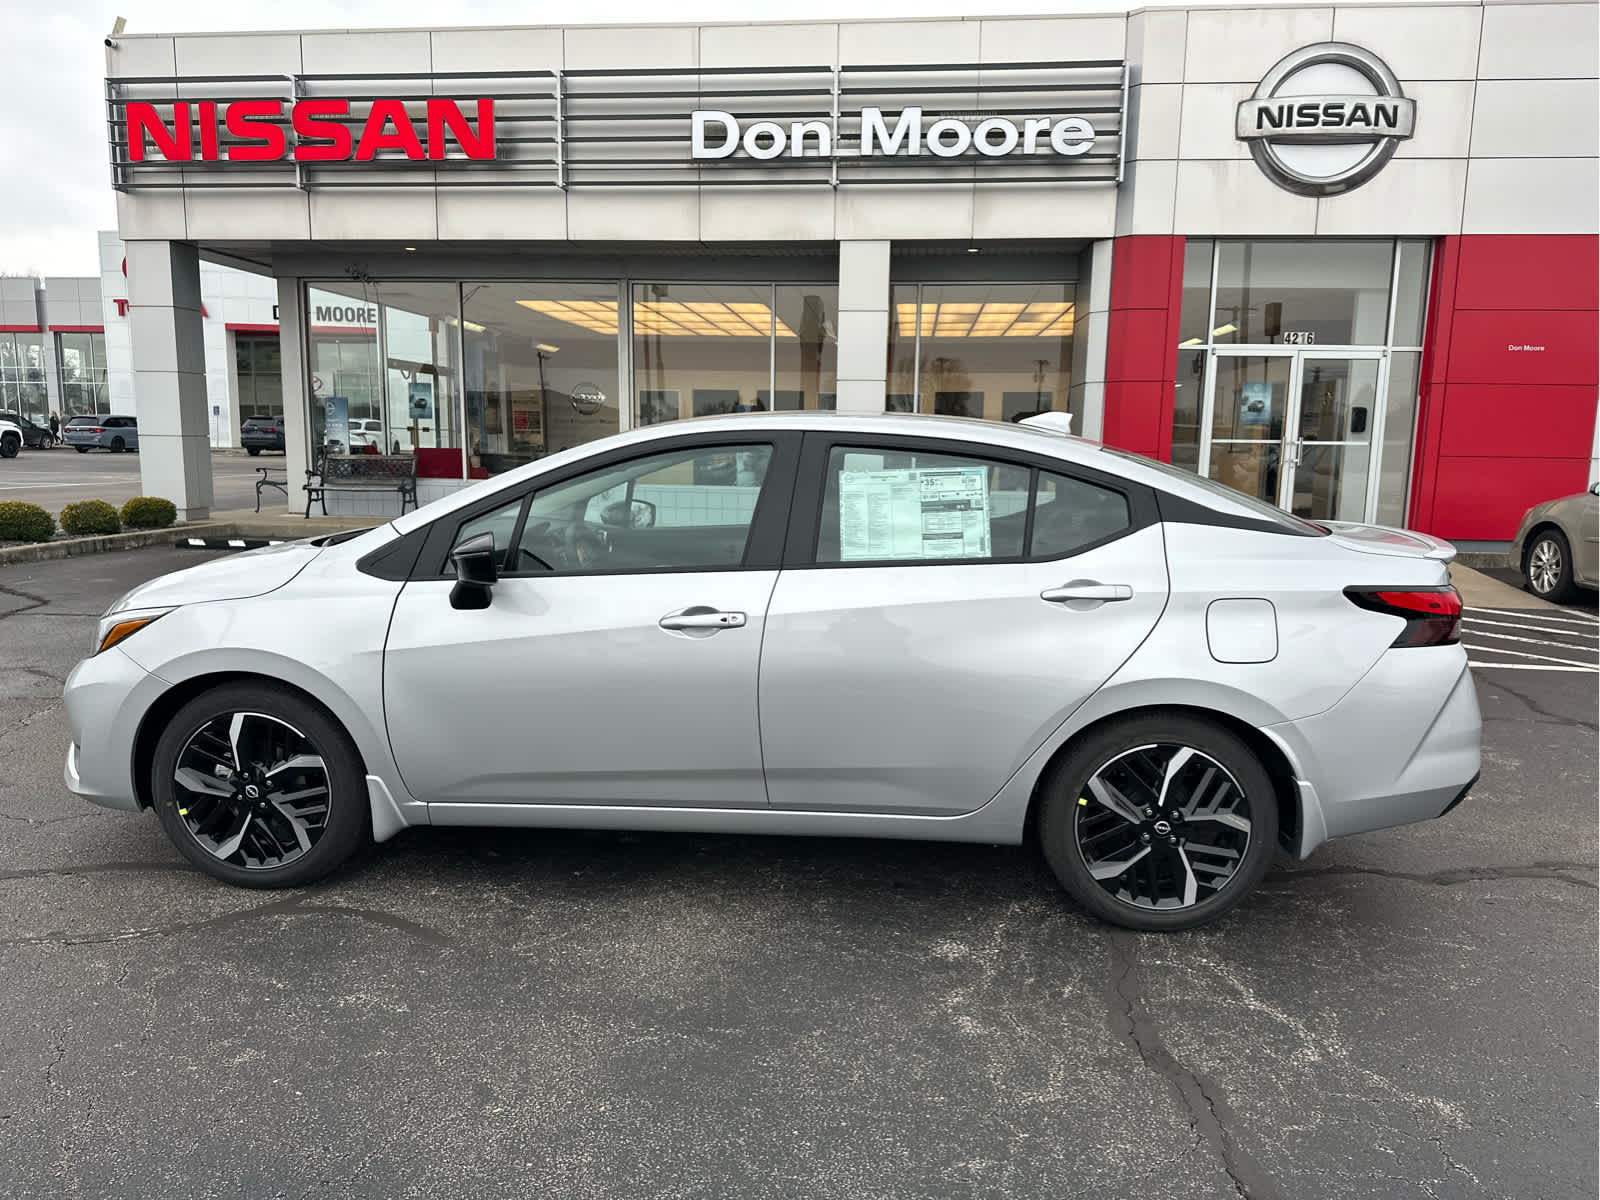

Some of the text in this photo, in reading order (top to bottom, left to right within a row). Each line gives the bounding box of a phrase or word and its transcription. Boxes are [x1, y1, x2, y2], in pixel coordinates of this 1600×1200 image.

[1256, 102, 1399, 130] NISSAN
[125, 98, 497, 163] NISSAN
[691, 105, 1097, 160] Don Moore
[316, 306, 377, 324] MOORE
[1285, 332, 1313, 345] 4216
[1508, 344, 1545, 352] Don Moore
